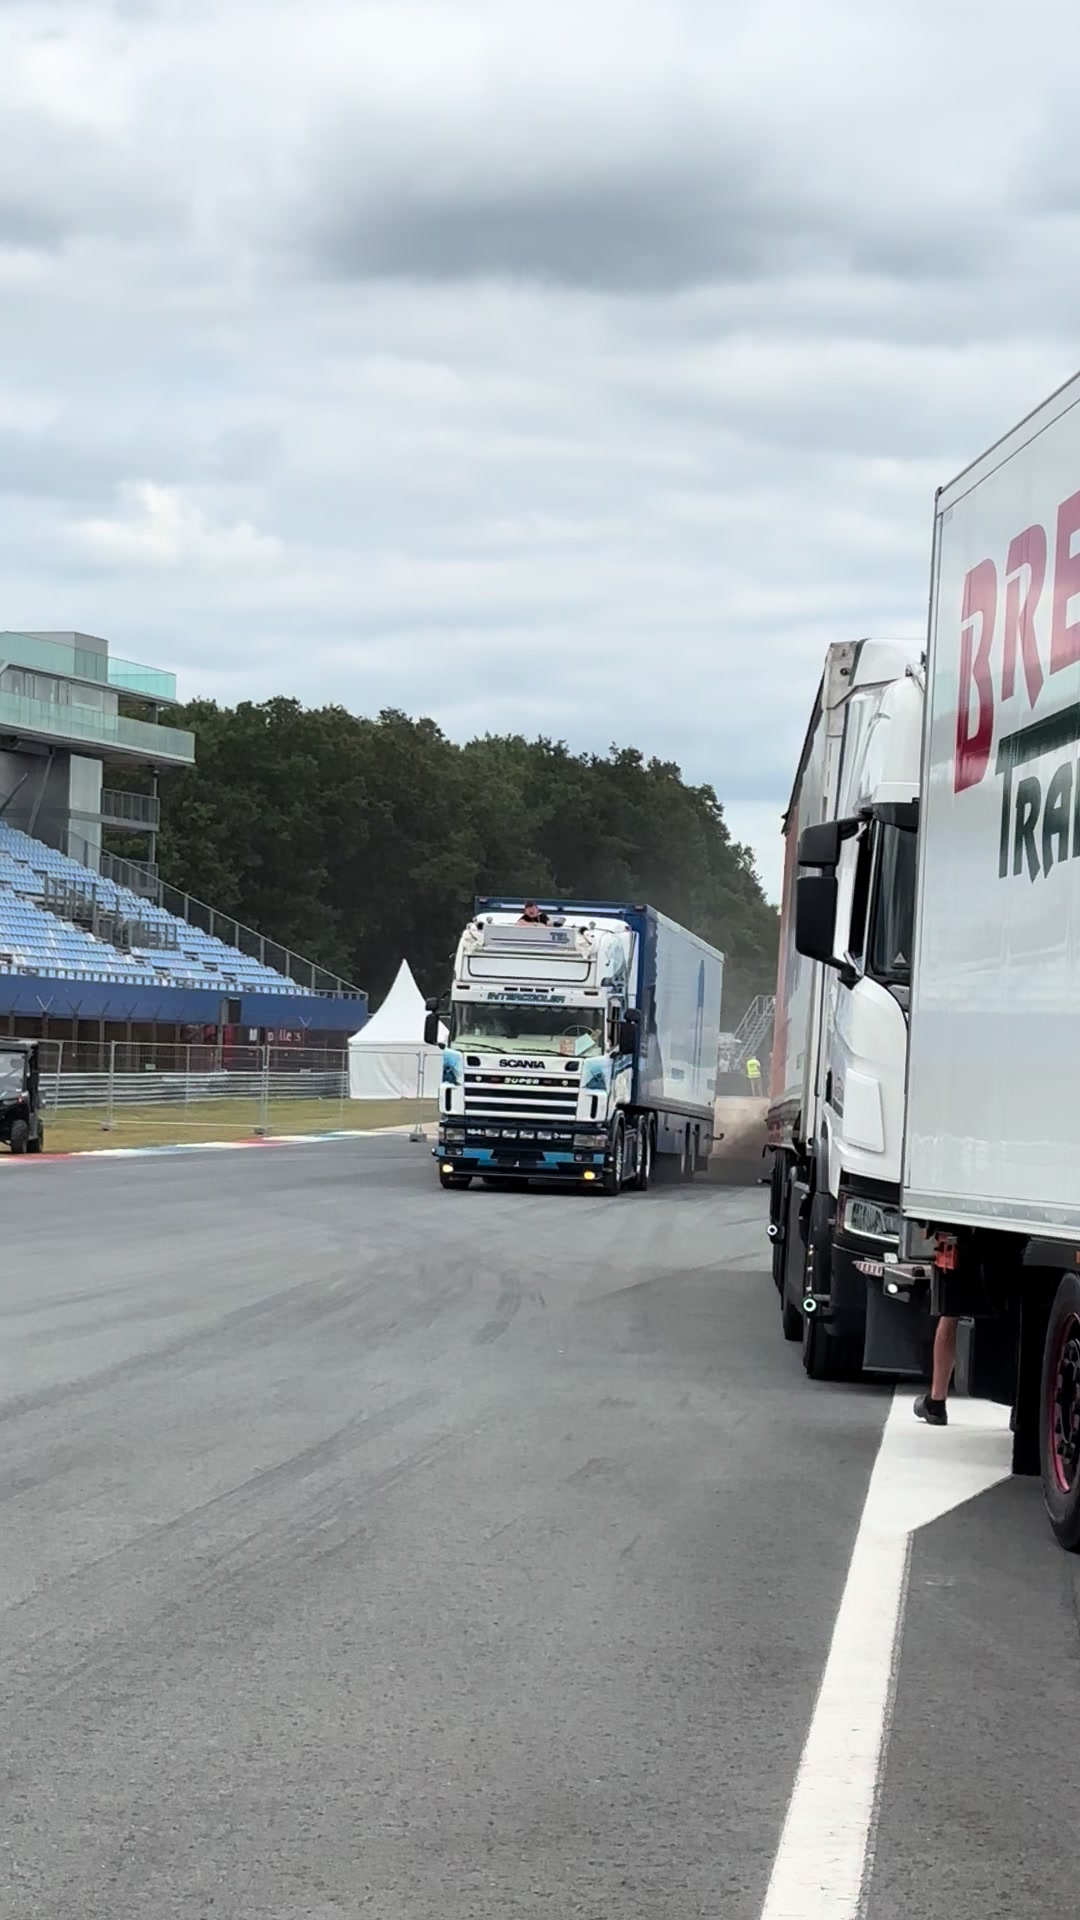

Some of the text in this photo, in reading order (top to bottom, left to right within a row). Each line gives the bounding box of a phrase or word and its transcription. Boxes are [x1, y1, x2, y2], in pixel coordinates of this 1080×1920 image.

[994, 702, 1080, 884] TRA
[499, 1059, 546, 1069] SCANIA
[504, 1077, 540, 1086] SUPER
